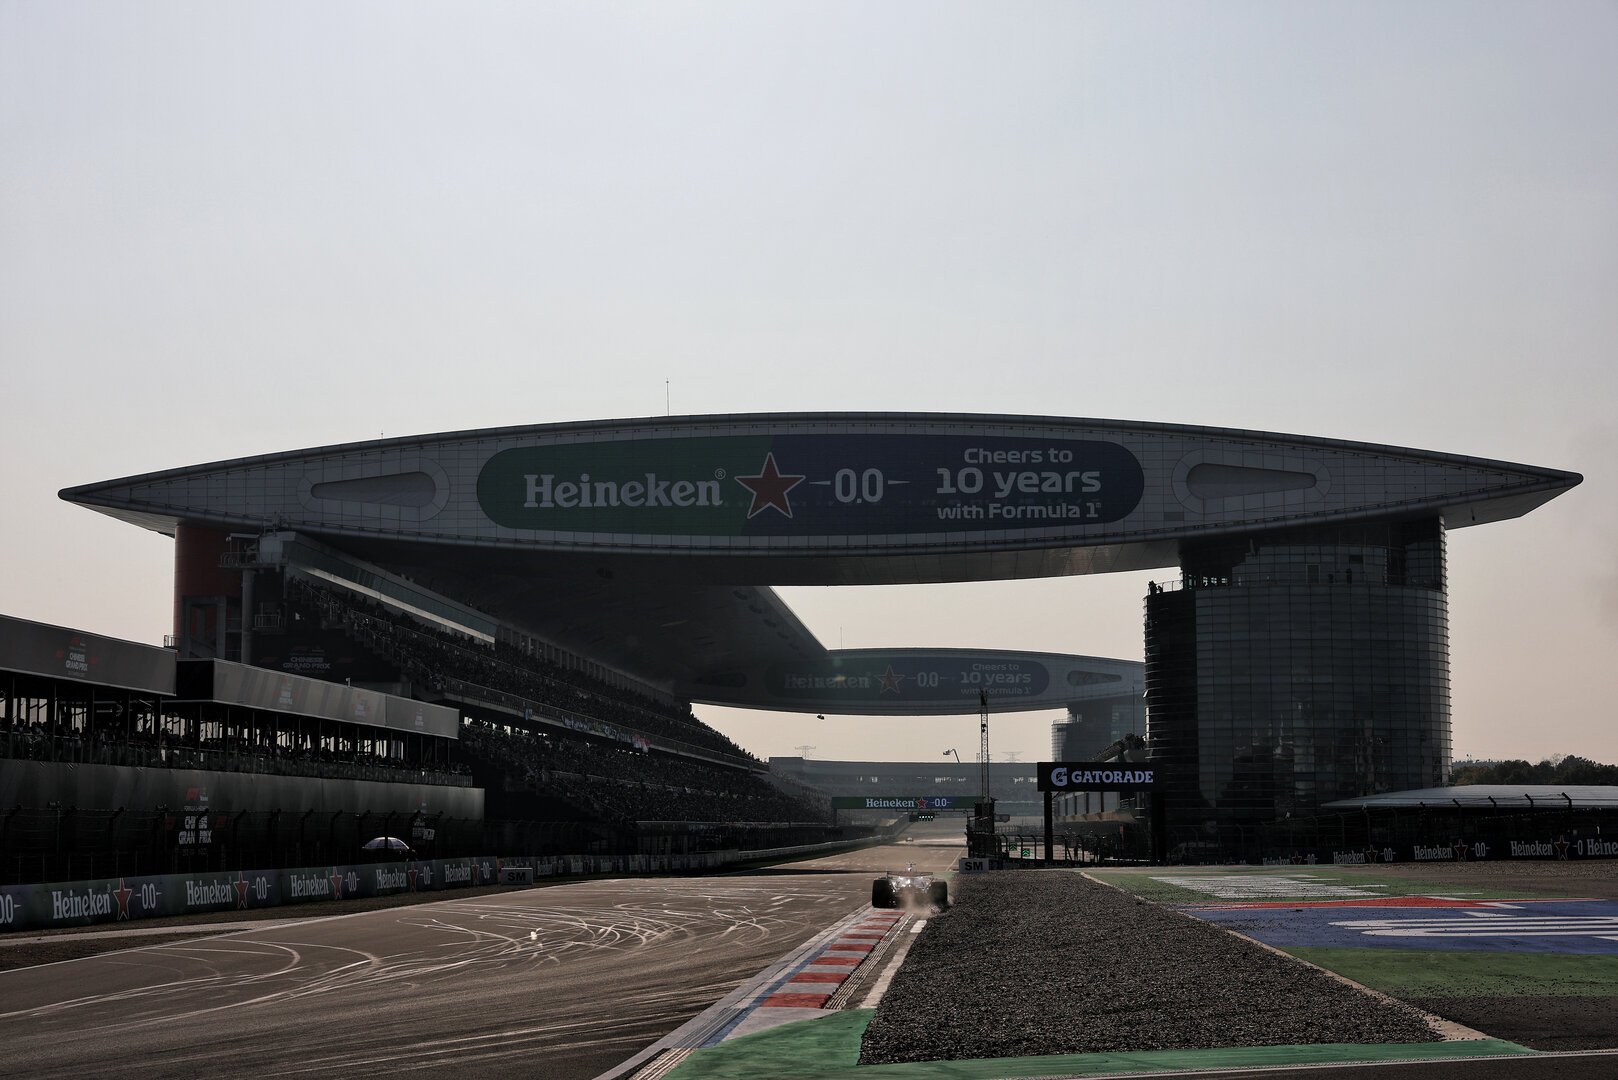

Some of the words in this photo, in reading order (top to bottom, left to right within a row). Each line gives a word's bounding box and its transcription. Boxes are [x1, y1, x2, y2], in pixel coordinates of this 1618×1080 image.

[964, 448, 1043, 464] Cheers
[1049, 448, 1073, 463] to
[937, 467, 984, 494] 10
[993, 470, 1101, 498] years
[937, 504, 984, 520] with
[988, 502, 1081, 519] Formula
[972, 663, 1007, 671] Cheers
[960, 671, 980, 684] 10
[984, 673, 1032, 686] years
[1071, 770, 1154, 784] GATORADE
[865, 798, 915, 808] Heineken
[1413, 844, 1453, 861] Heineken
[1510, 840, 1554, 857] Heineken
[964, 861, 984, 871] SM
[289, 873, 330, 897] Heineken
[507, 872, 527, 882] SM
[186, 880, 233, 906] Heineken
[52, 889, 112, 920] Heineken
